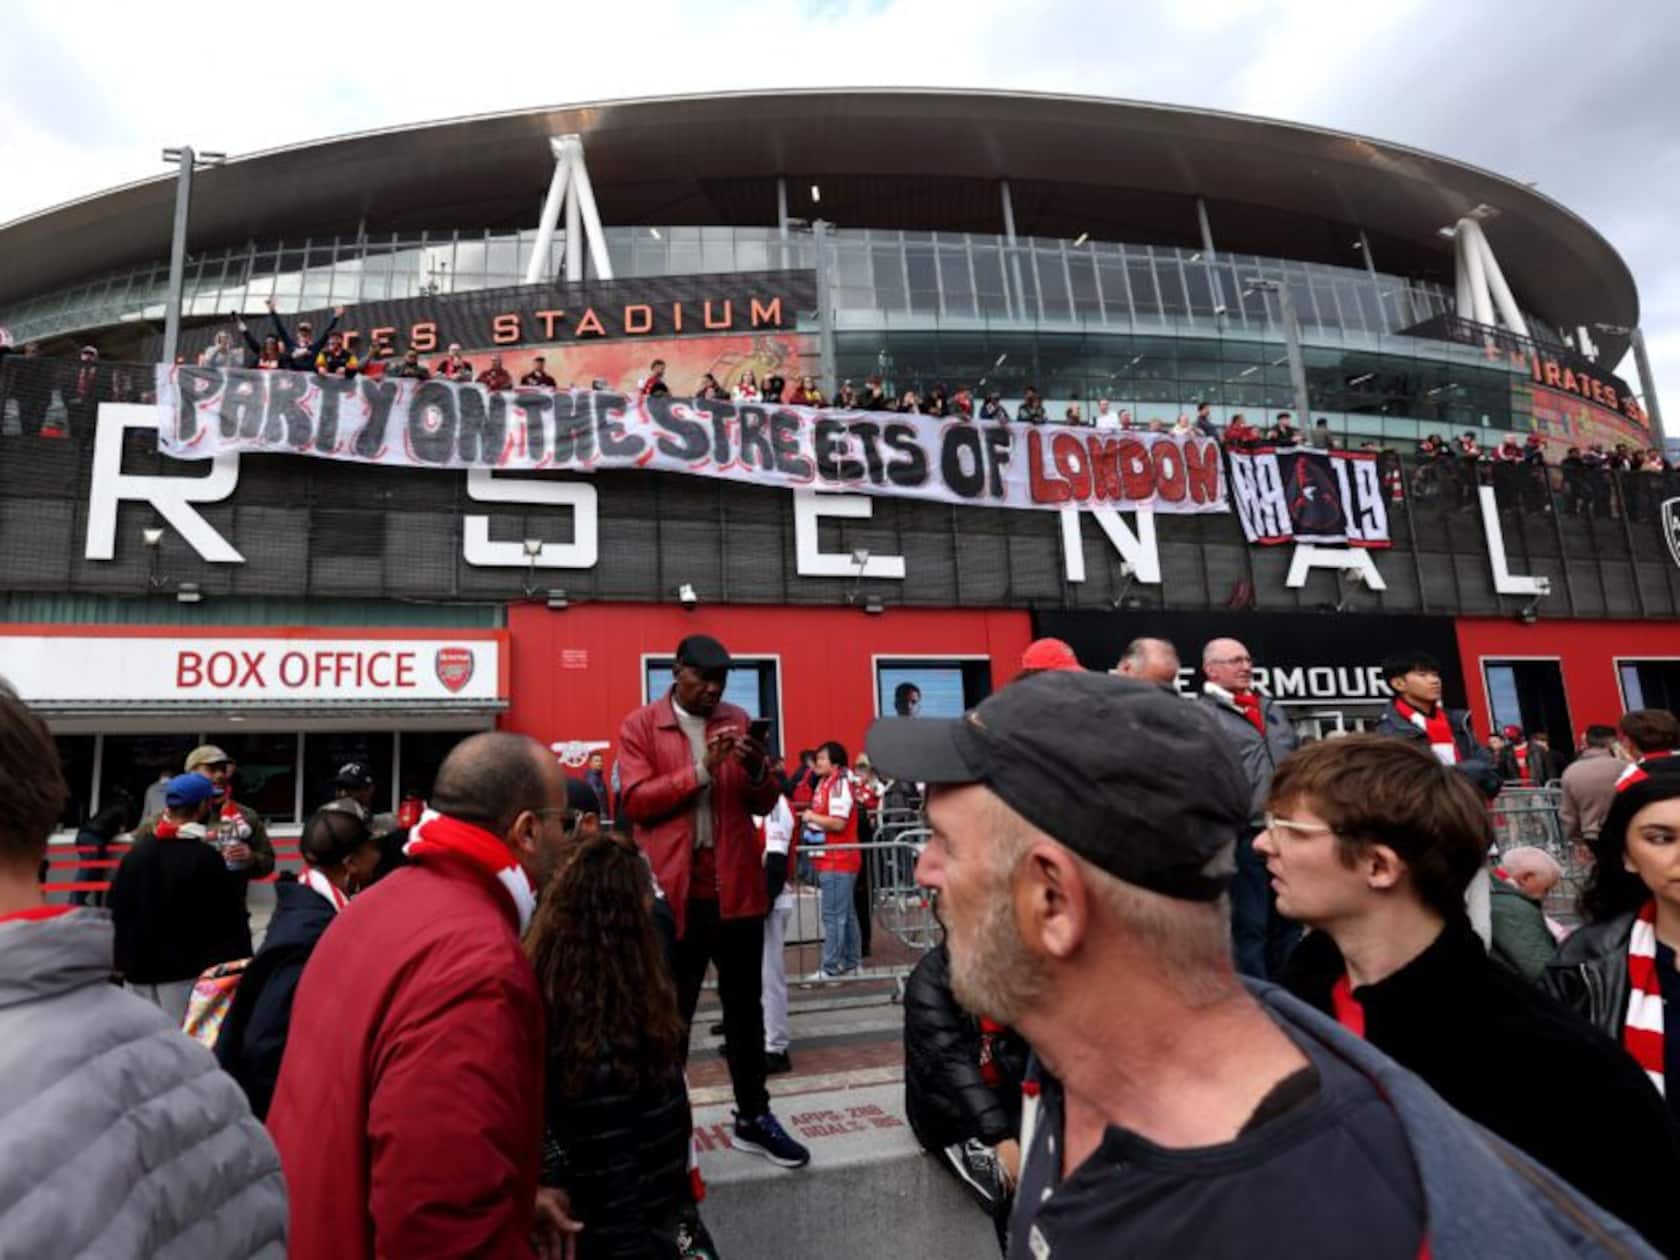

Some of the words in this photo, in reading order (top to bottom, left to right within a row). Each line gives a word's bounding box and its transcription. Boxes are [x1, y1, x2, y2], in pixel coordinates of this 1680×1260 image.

[493, 297, 782, 344] STADIUM
[178, 367, 398, 456] PARTY
[408, 382, 506, 464] ON
[514, 391, 646, 463] THE
[646, 396, 930, 487] STREETS
[940, 423, 1011, 499] OF
[1027, 429, 1218, 503] LONDON
[1329, 456, 1391, 541] 19
[176, 651, 267, 689] BOX
[279, 651, 417, 688] OFFICE
[1250, 666, 1395, 697] RMOUR
